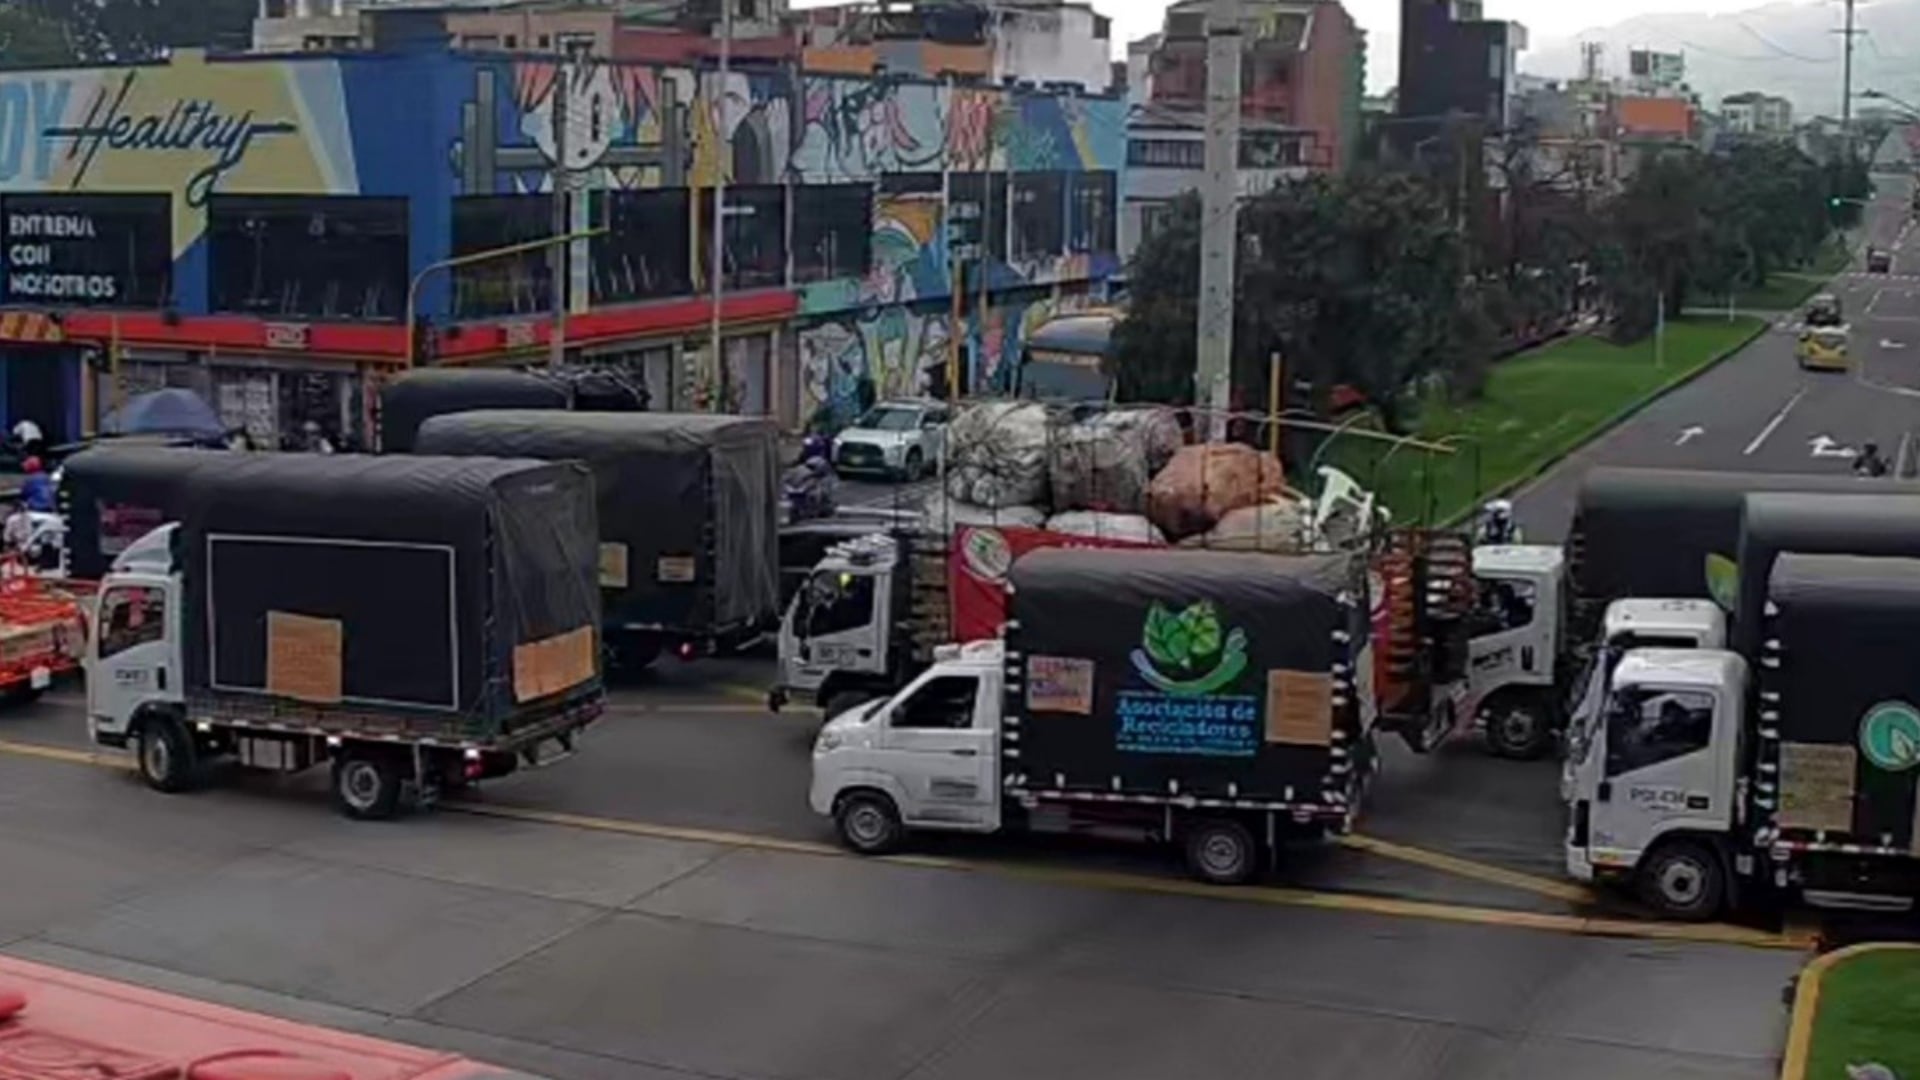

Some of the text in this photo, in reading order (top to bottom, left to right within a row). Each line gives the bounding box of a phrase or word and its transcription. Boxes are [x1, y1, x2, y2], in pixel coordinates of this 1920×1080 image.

[42, 70, 297, 208] Healthy
[9, 244, 51, 265] CON
[9, 273, 116, 297] NOSOTROS
